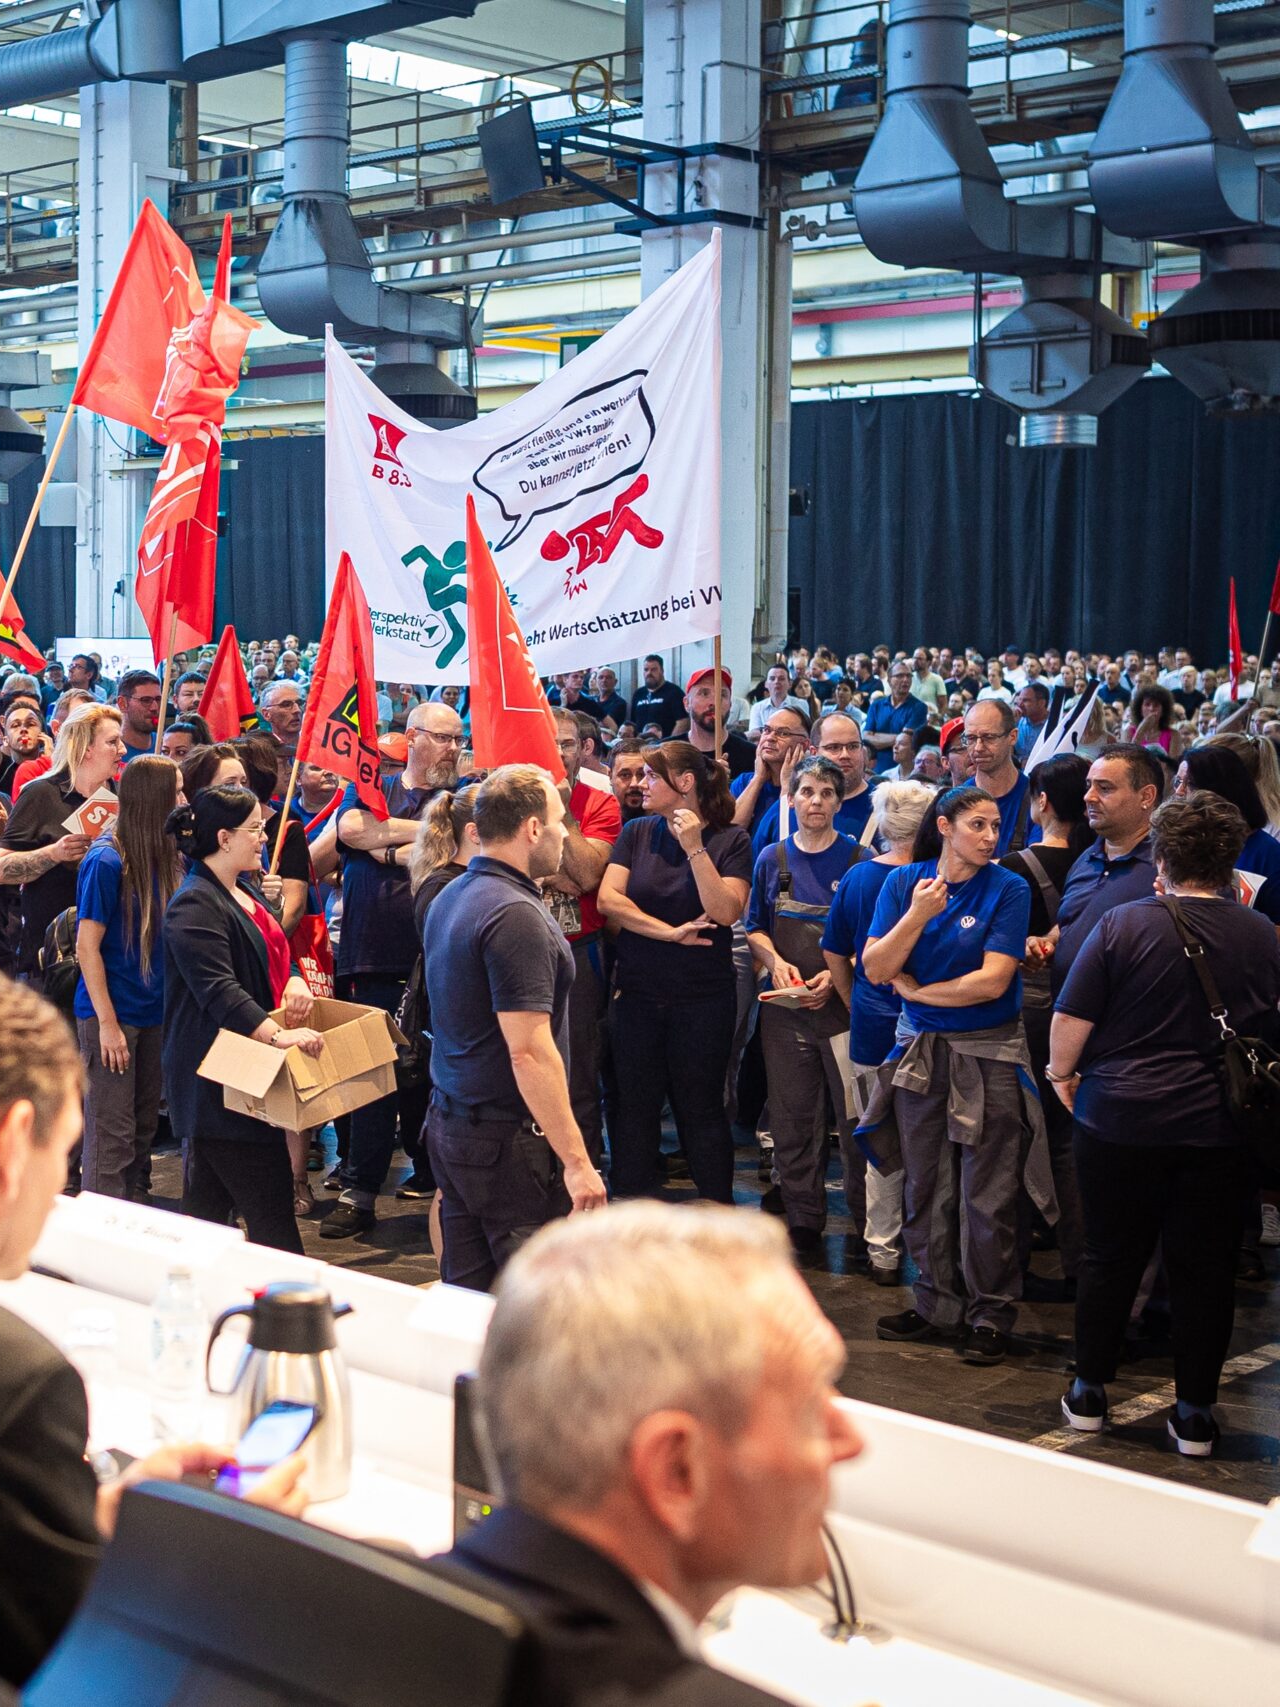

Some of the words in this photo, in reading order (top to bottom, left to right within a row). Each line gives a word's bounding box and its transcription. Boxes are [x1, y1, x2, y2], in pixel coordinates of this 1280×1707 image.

[532, 428, 563, 447] fleißig
[563, 418, 583, 432] und
[584, 409, 601, 420] ein
[527, 456, 550, 471] aber
[551, 450, 566, 463] wir
[372, 463, 384, 479] B
[388, 469, 412, 488] 8.3
[519, 480, 537, 494] Du
[549, 601, 668, 641] Wertschätzung
[671, 590, 696, 613] bei
[373, 621, 422, 642] erkstatt
[321, 722, 352, 758] IG
